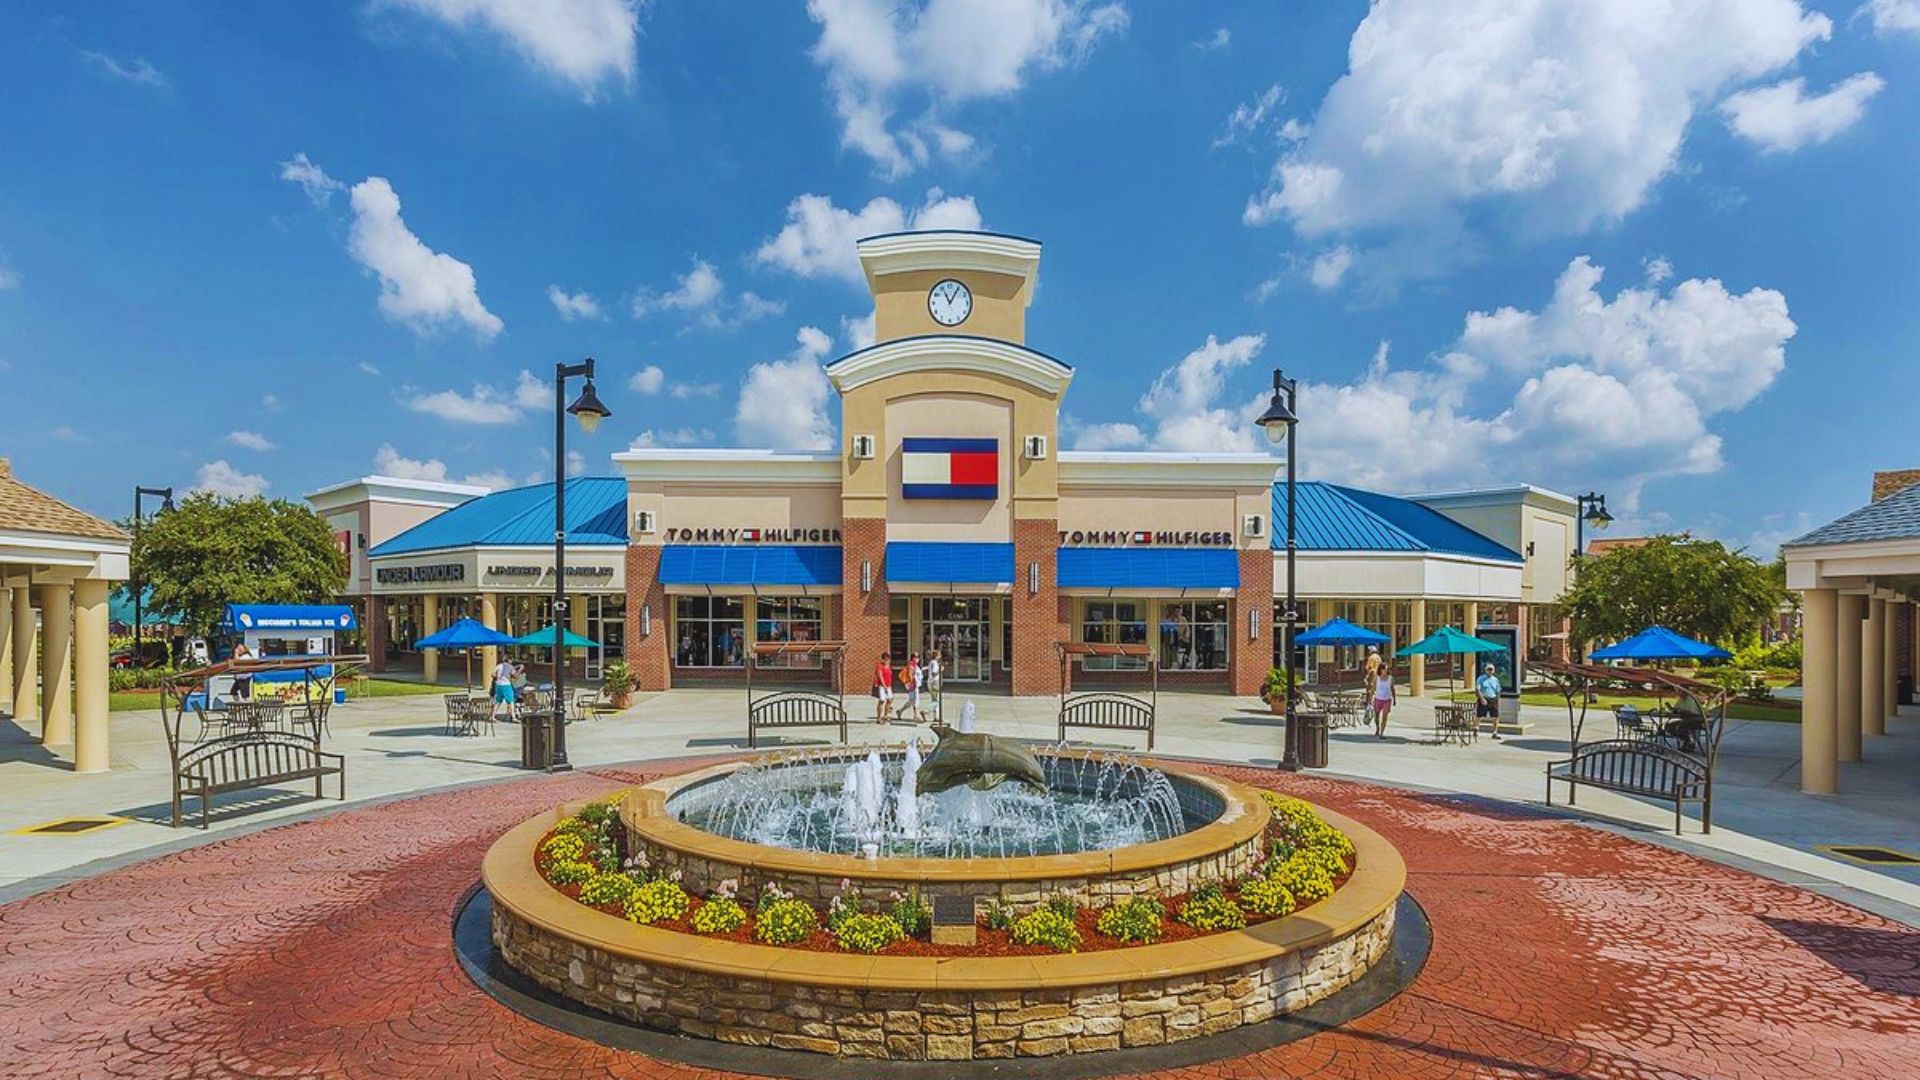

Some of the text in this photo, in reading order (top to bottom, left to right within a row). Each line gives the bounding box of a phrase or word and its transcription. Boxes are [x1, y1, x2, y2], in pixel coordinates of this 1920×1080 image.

[667, 528, 842, 542] TOMMY HILFIGER
[1059, 531, 1233, 545] TOMMY HILFIGER
[377, 564, 464, 583] UNDER ARMOUR
[487, 565, 542, 576] UNDER
